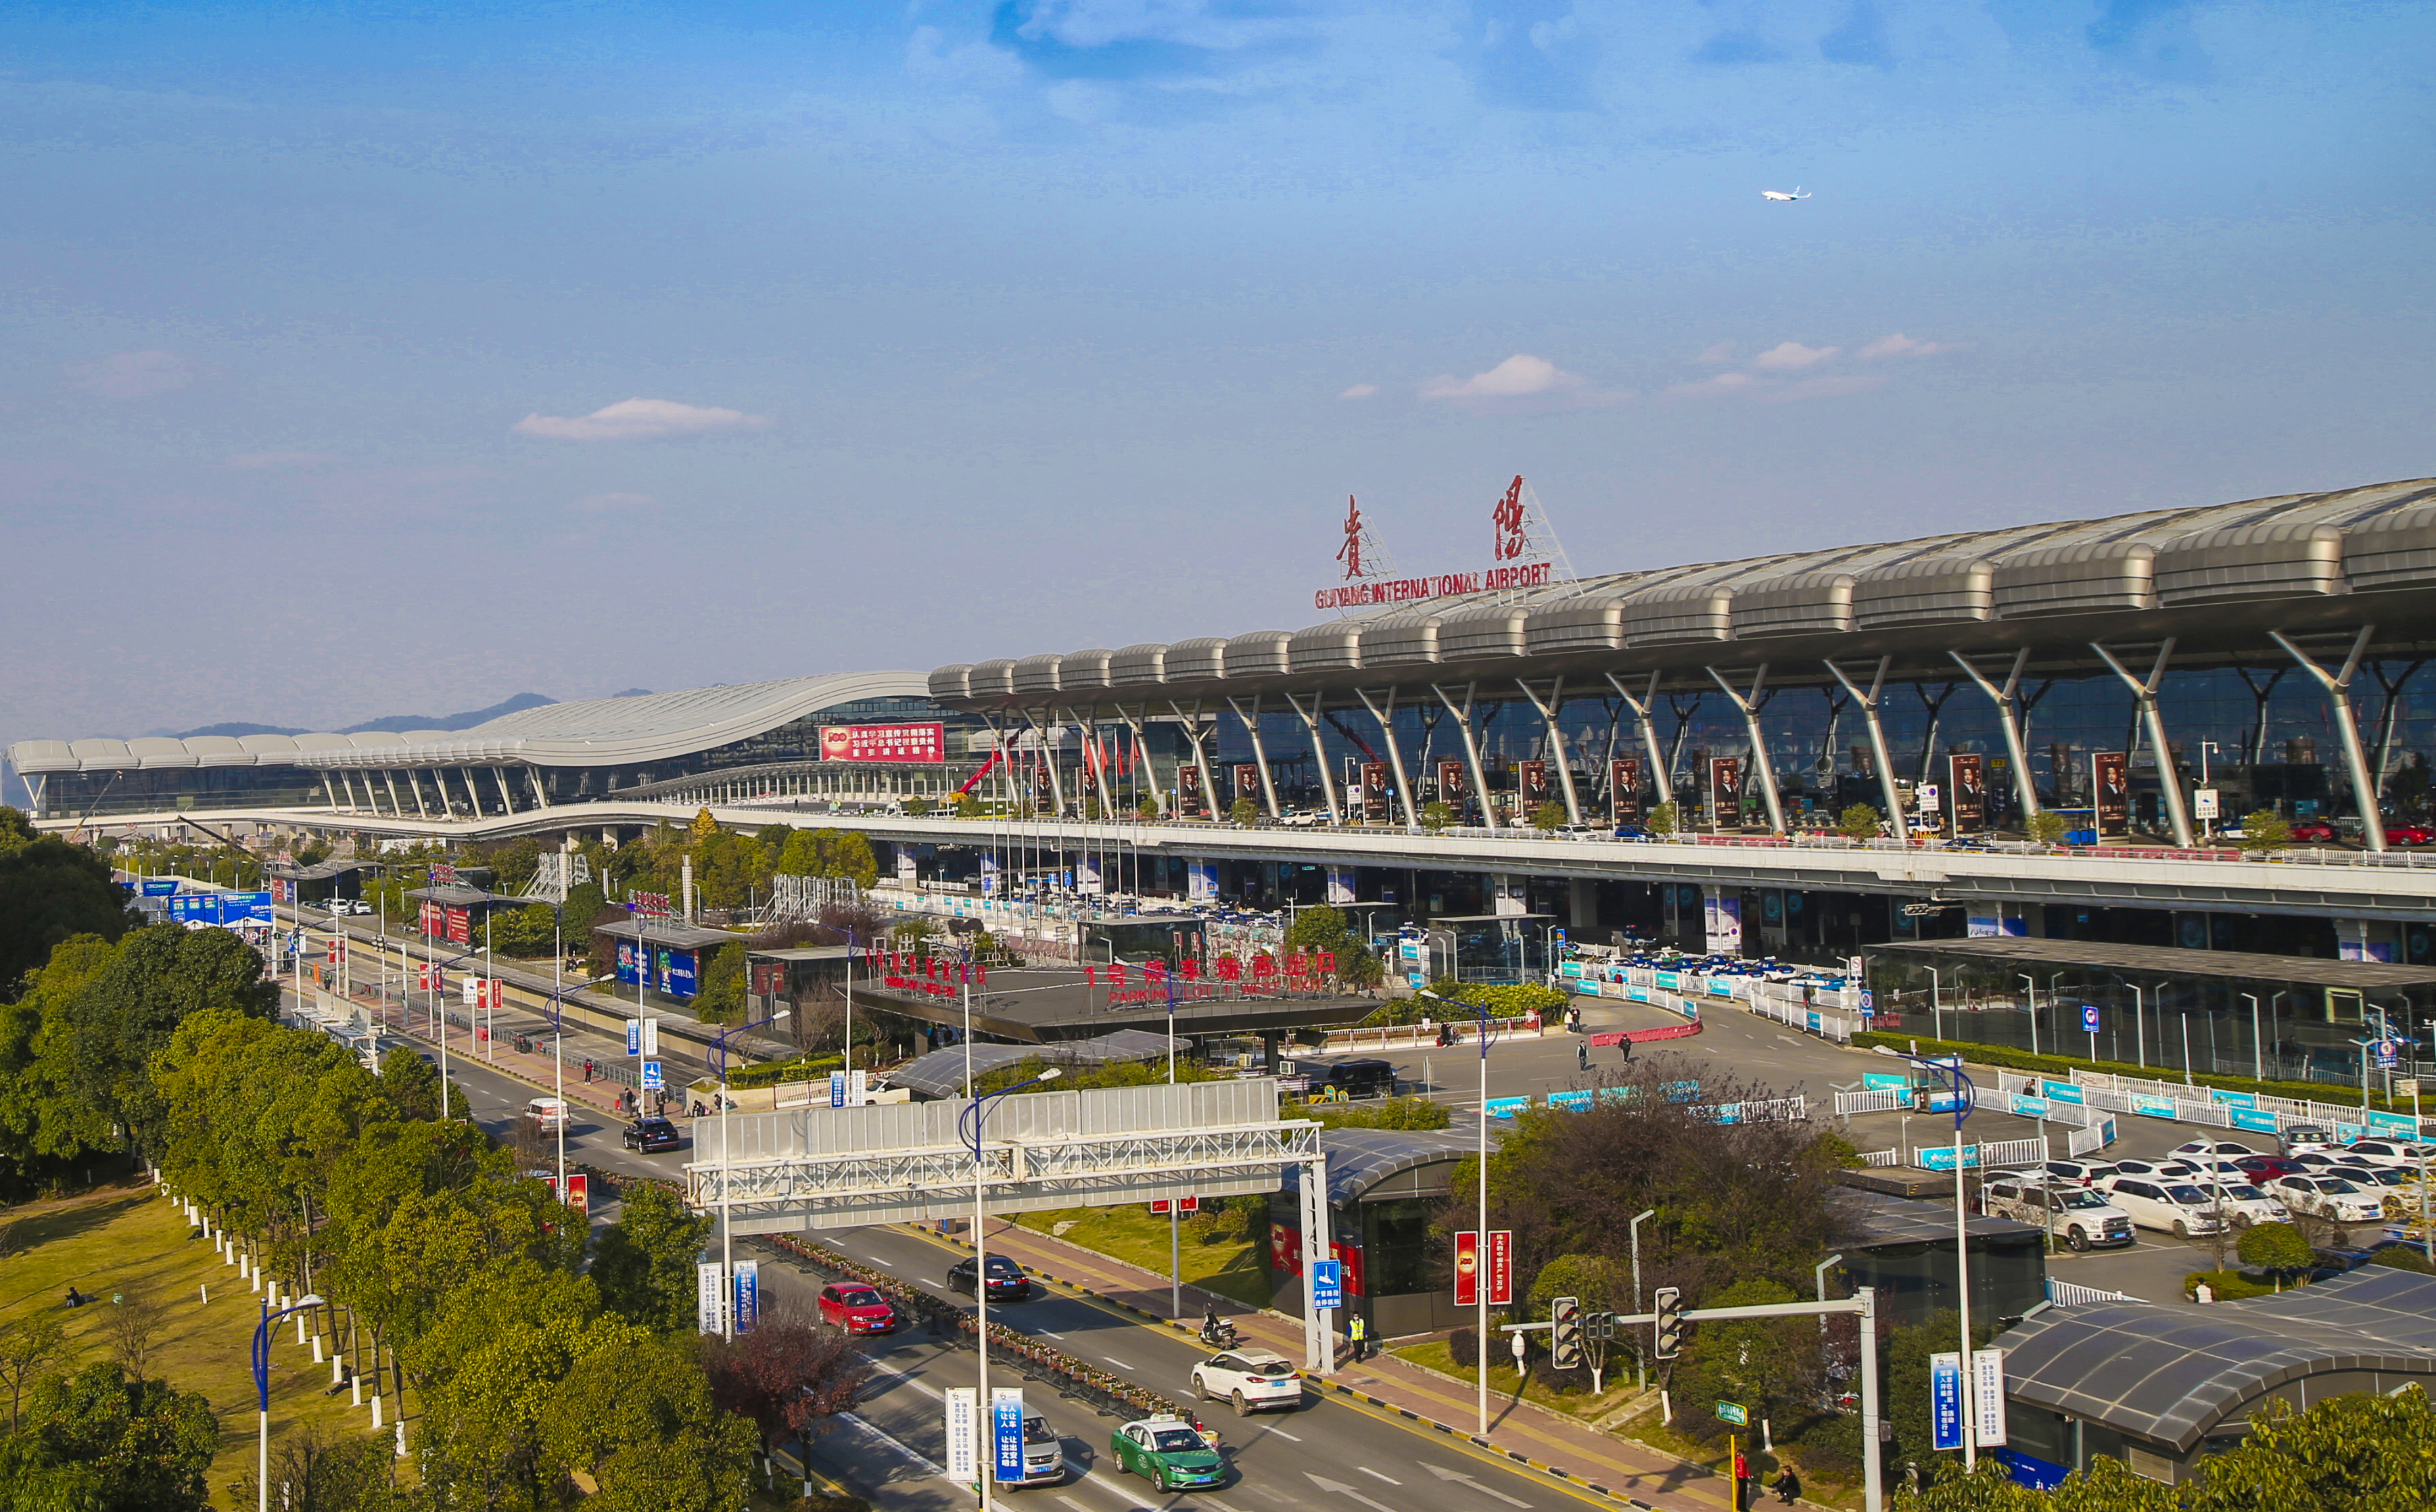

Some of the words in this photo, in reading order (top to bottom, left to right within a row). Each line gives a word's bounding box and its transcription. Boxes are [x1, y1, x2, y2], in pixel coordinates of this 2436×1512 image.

[1315, 584, 1369, 609] GUIYANG
[1372, 572, 1480, 603] INTERNATIONAL
[1485, 563, 1551, 590] AIRPORT
[1083, 952, 1335, 988] 1号停车场西出口
[1109, 989, 1174, 1003] PARKING
[1184, 985, 1213, 999] LOT
[1223, 985, 1229, 995] 1
[1240, 981, 1279, 995] WEST
[1290, 979, 1323, 992] EXIT
